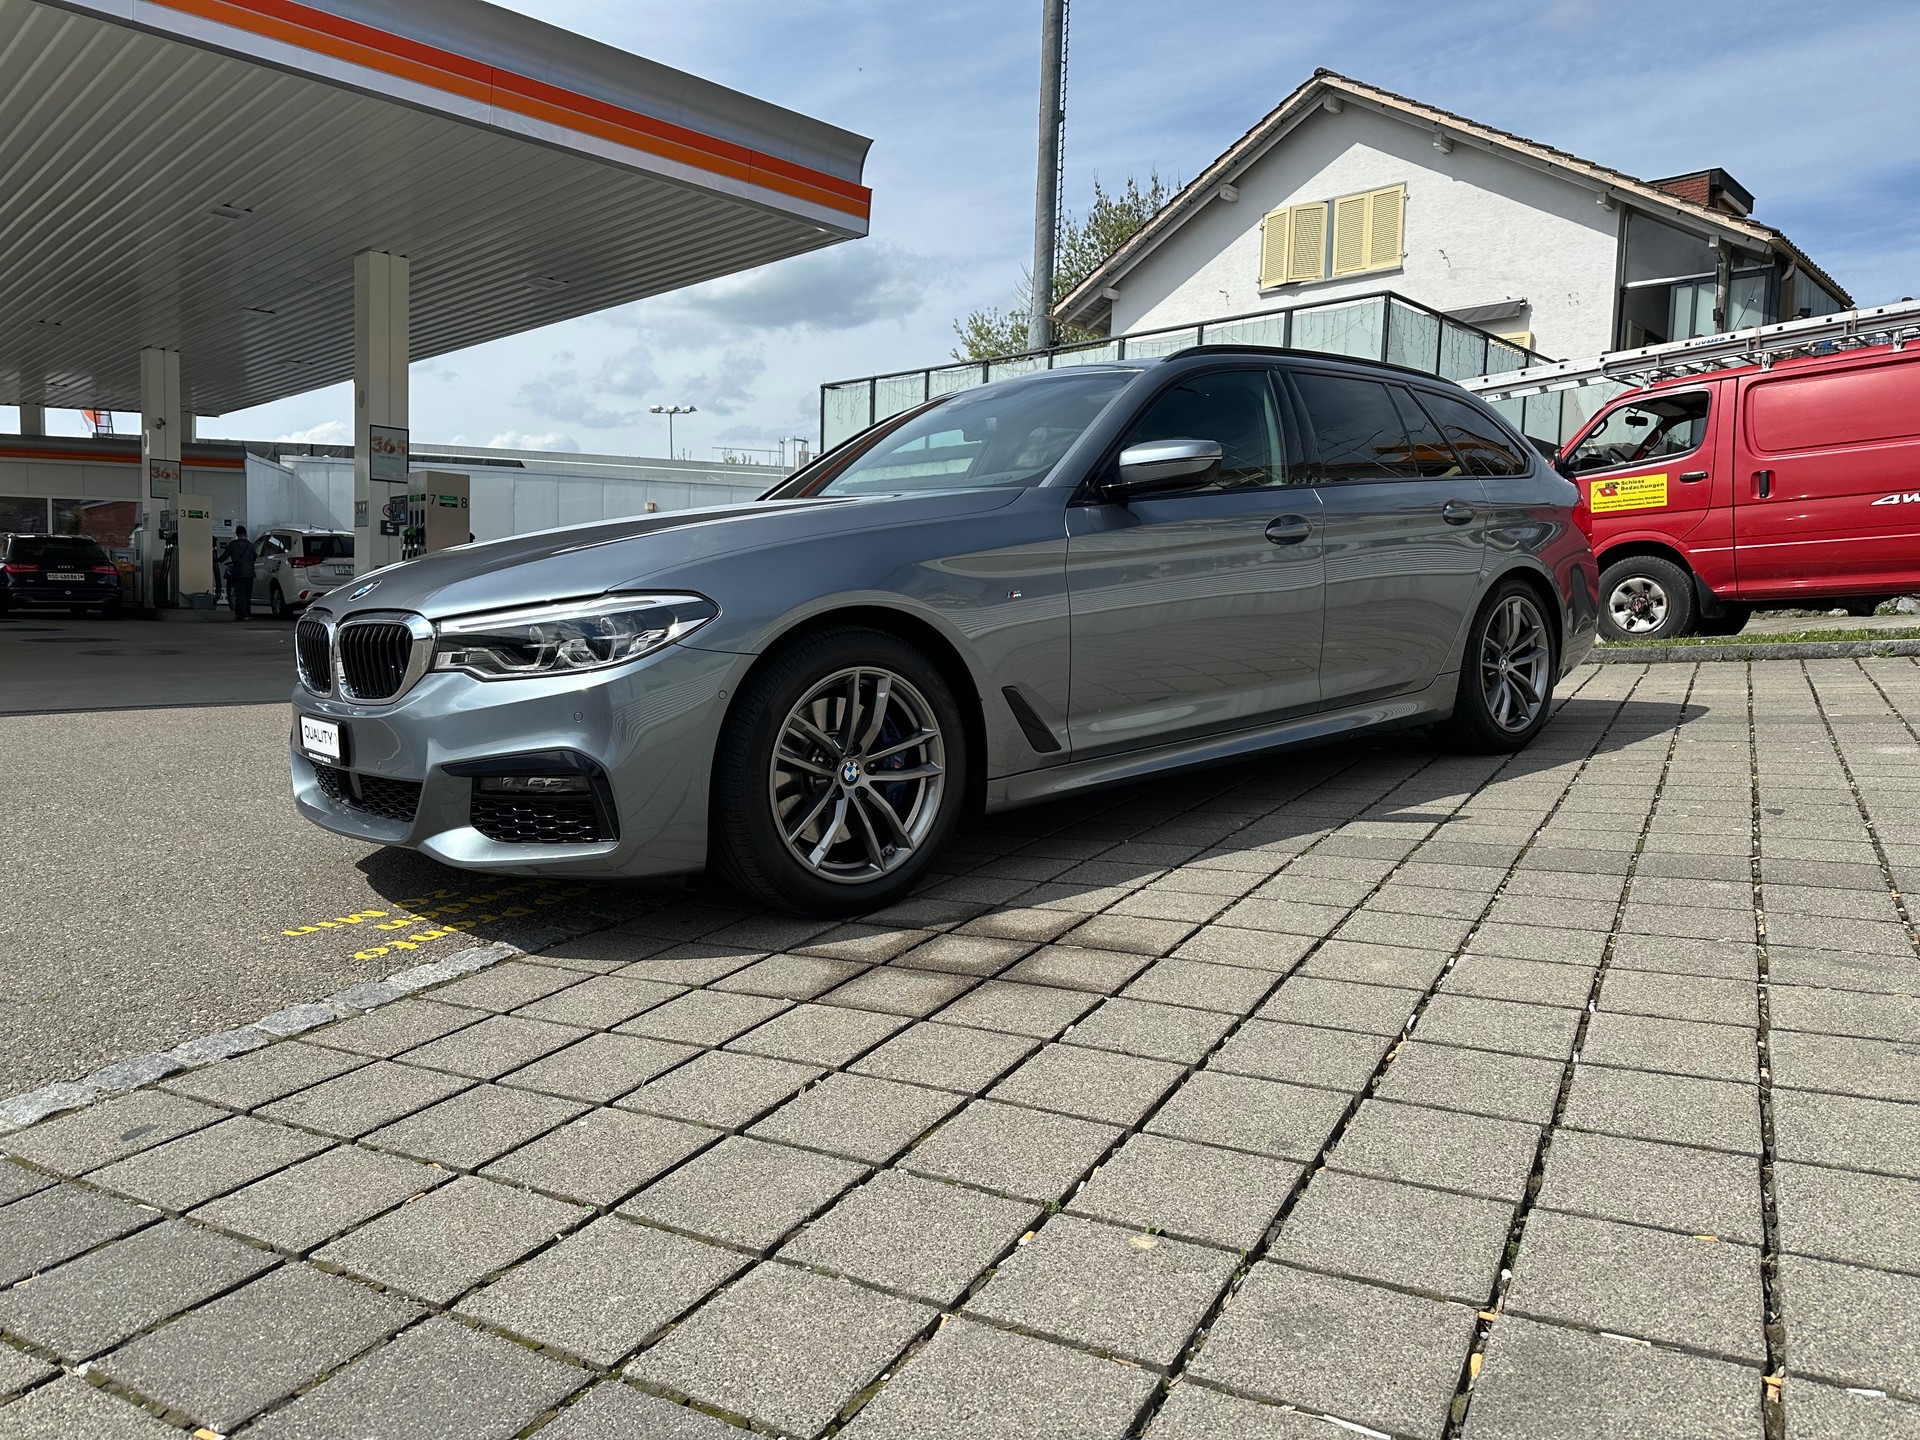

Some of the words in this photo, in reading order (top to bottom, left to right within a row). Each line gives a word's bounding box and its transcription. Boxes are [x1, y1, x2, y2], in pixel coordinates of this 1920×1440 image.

[1620, 482, 1665, 491] Bedachungen
[430, 494, 436, 505] 7
[460, 497, 468, 509] 8
[180, 509, 187, 518] 3
[203, 511, 210, 519] 4
